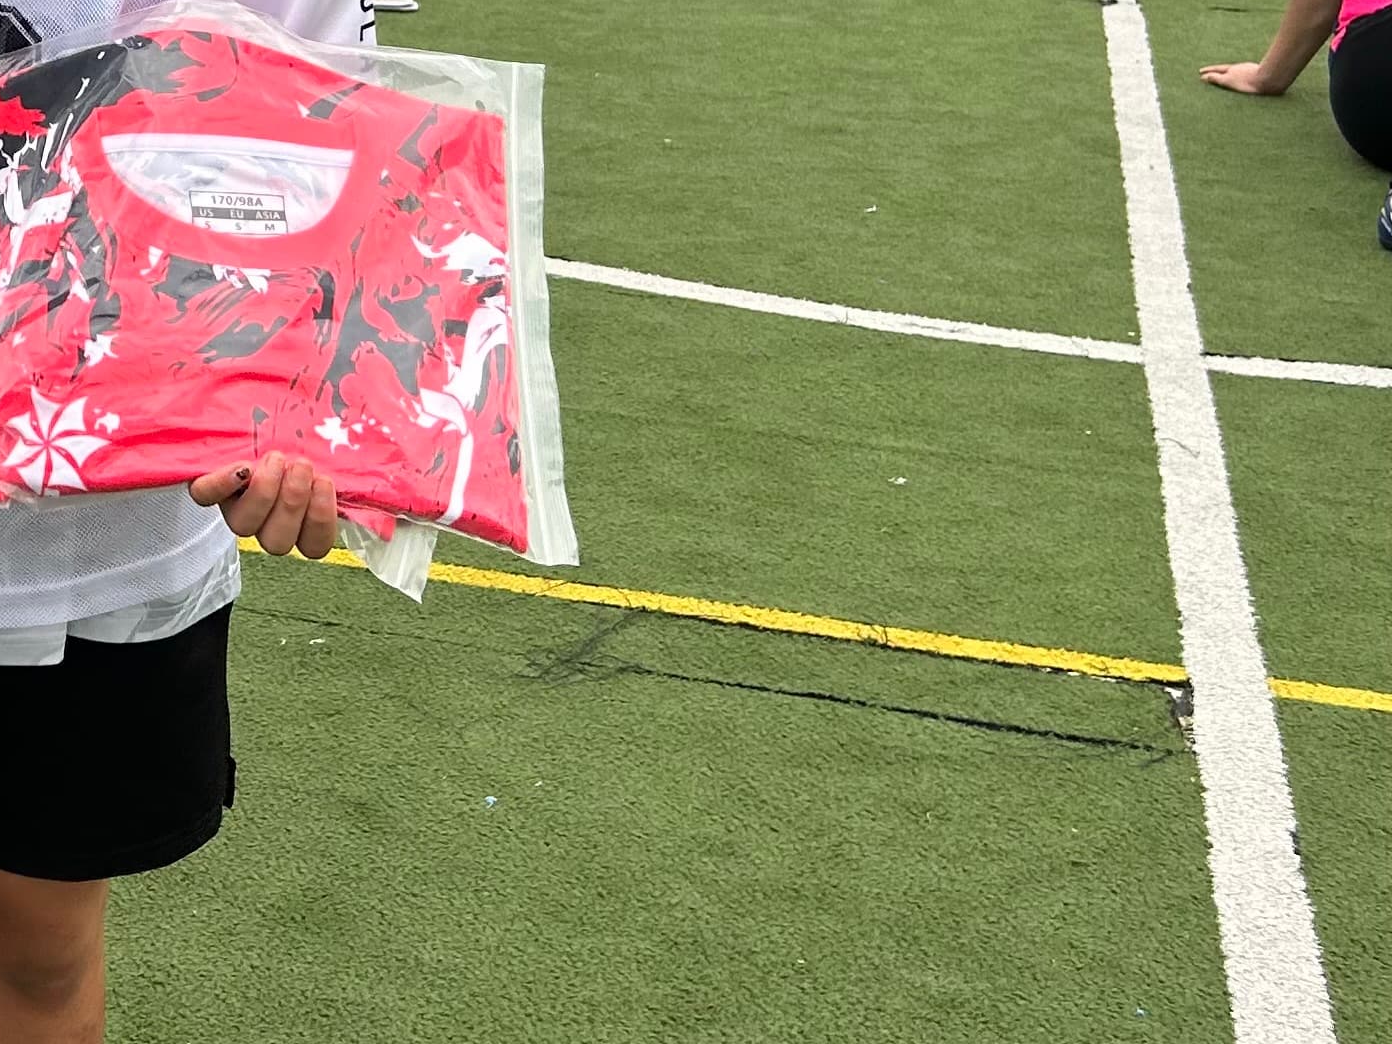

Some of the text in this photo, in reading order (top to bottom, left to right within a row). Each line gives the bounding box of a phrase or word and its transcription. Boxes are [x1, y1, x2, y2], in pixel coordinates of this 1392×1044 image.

[211, 195, 263, 207] 170/98A
[199, 208, 280, 220] US EU ASIA
[235, 222, 242, 230] S
[265, 223, 275, 231] M
